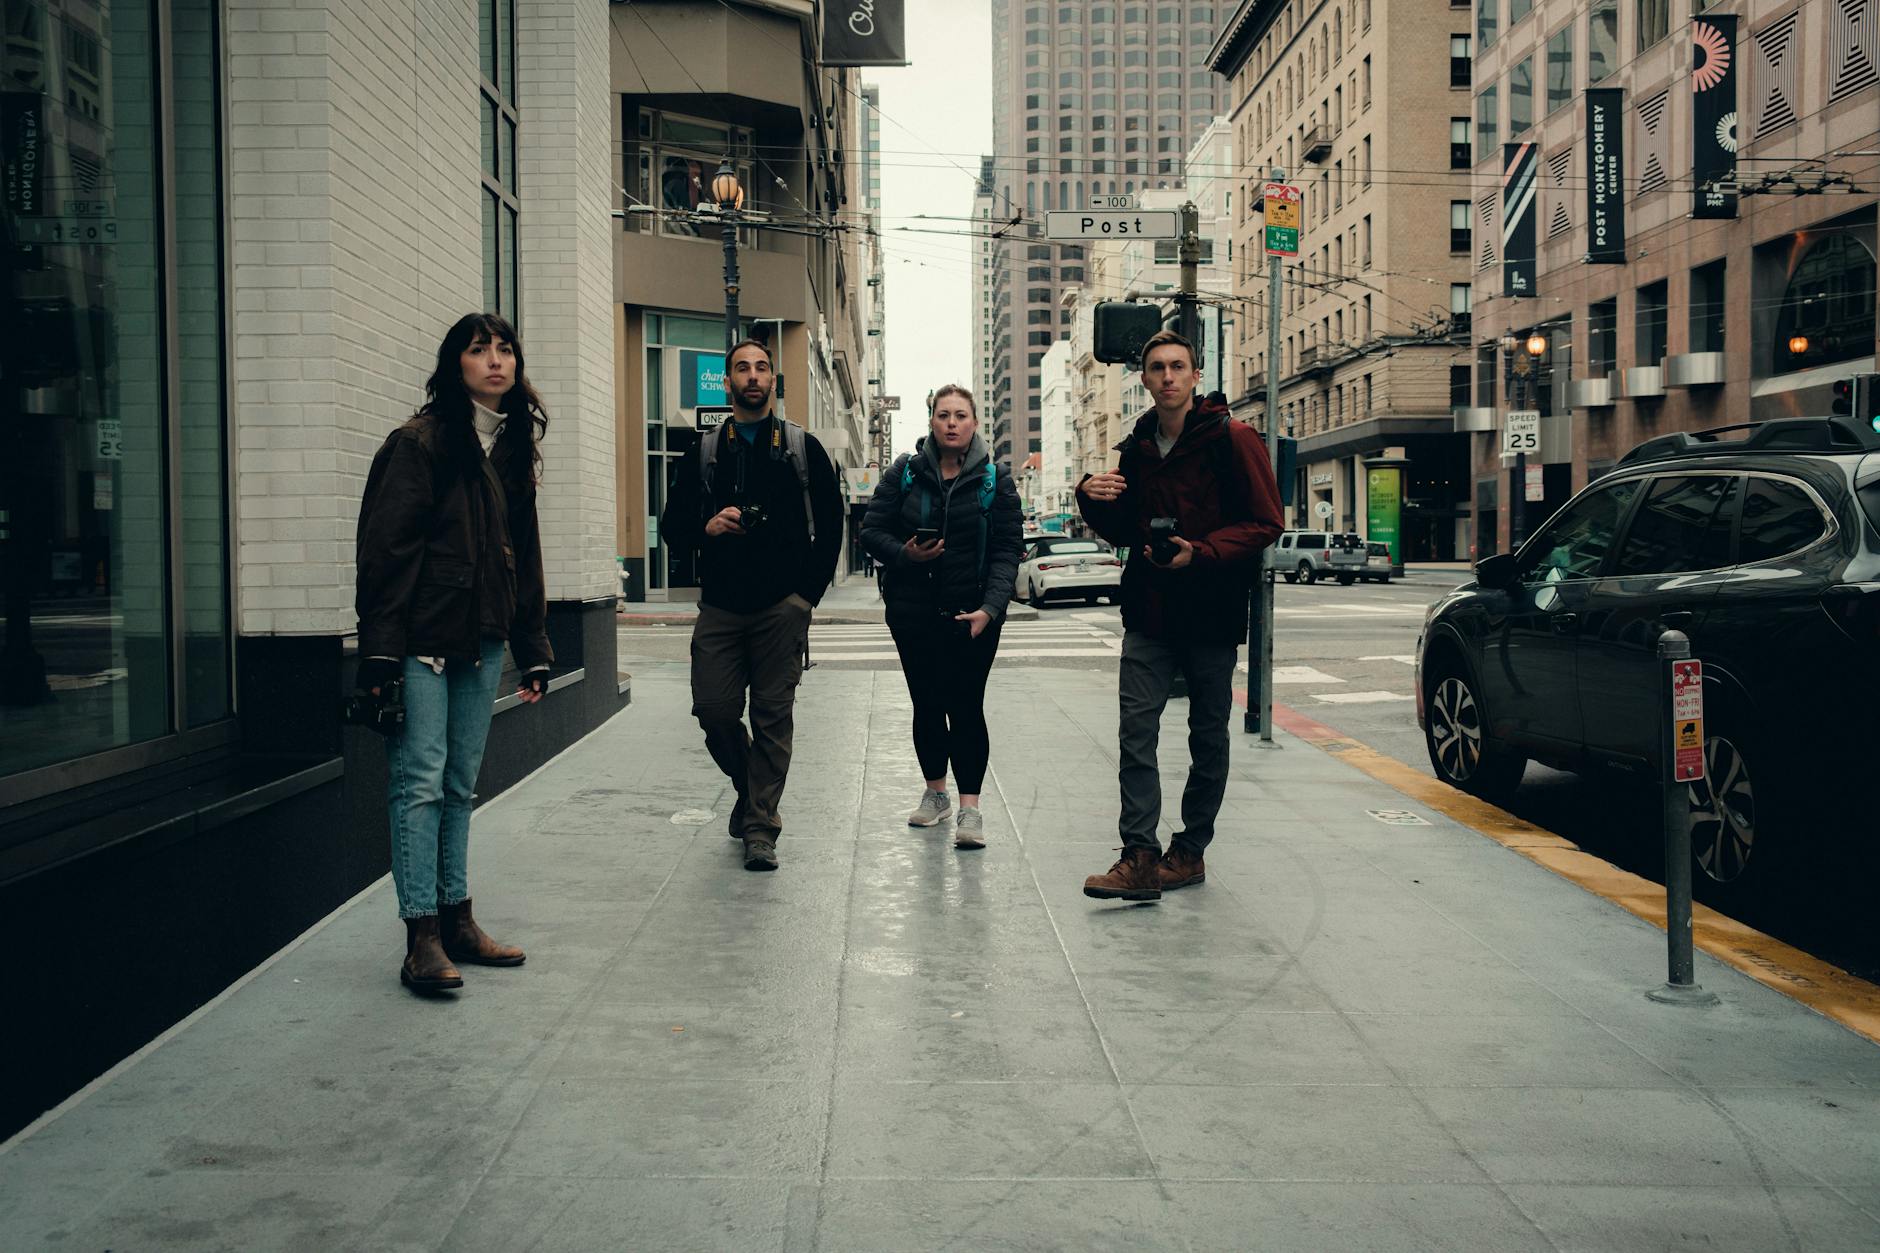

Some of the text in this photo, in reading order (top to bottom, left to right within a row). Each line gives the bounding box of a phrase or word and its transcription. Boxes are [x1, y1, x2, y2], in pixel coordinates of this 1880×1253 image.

[1594, 104, 1606, 246] POST MONTGOMERY
[1107, 197, 1127, 208] 100
[1081, 217, 1142, 233] Post
[701, 369, 726, 381] charl
[704, 414, 724, 424] ONE
[1511, 434, 1536, 448] 25
[1675, 688, 1684, 697] NO
